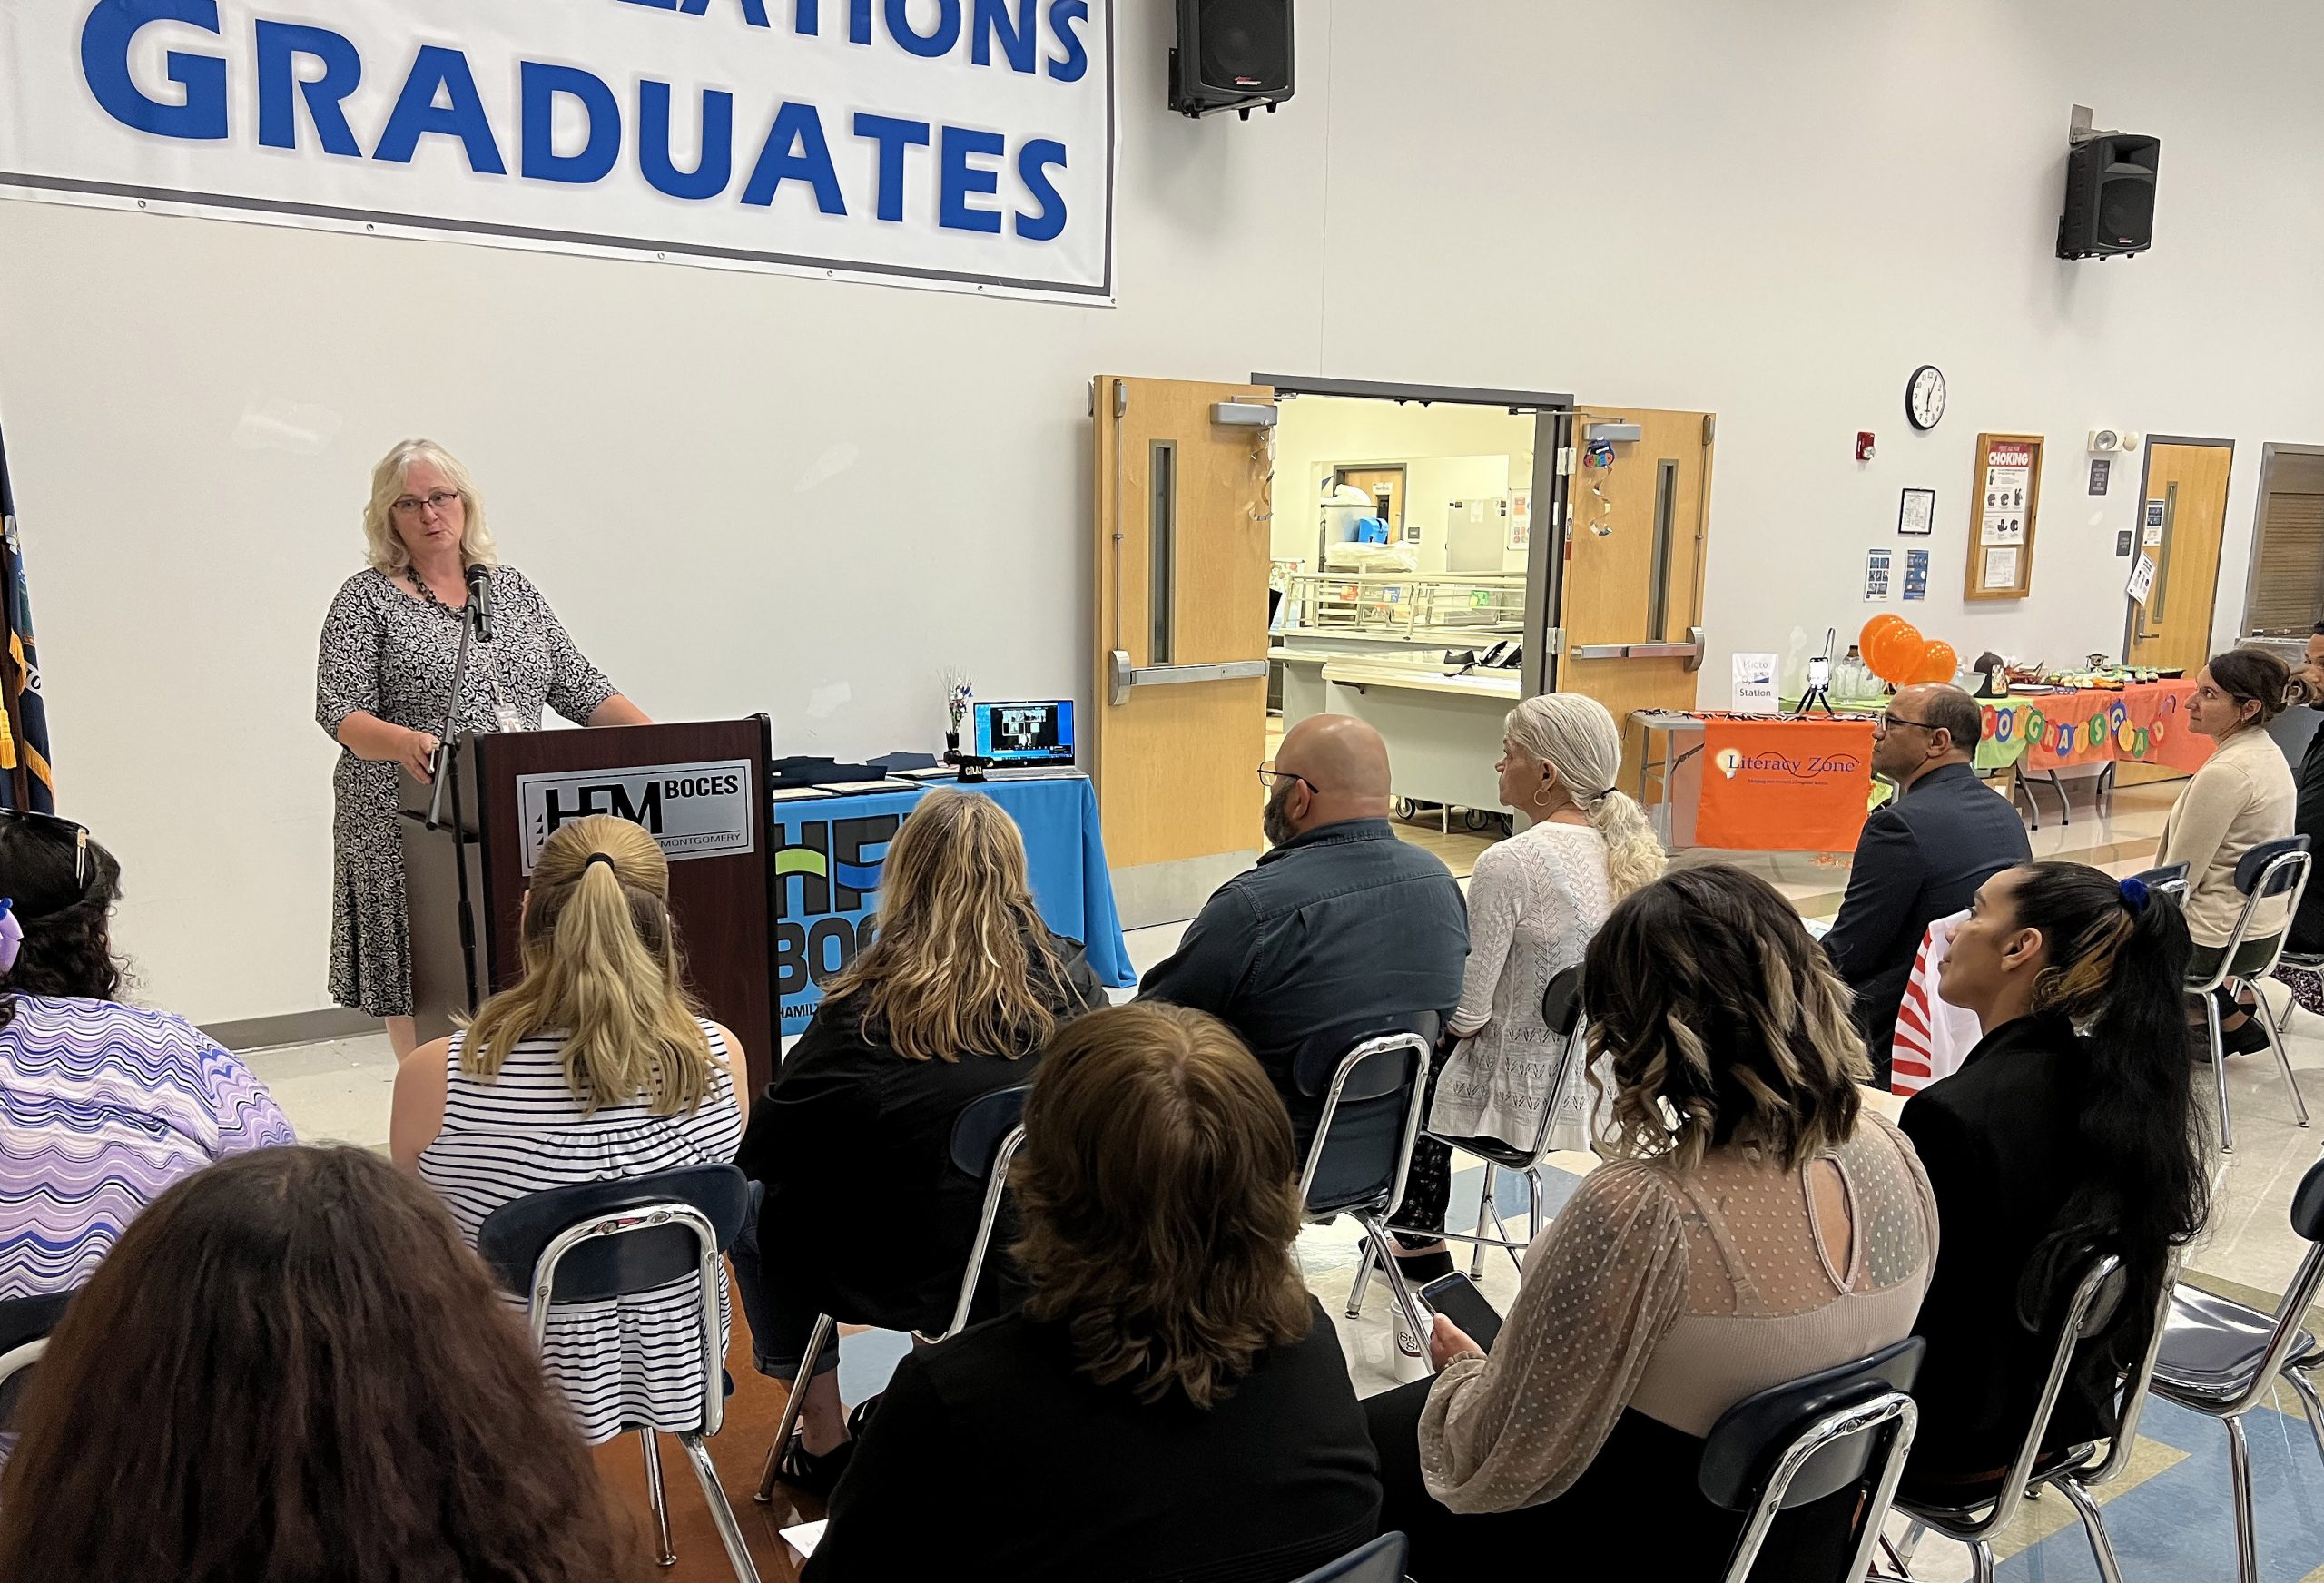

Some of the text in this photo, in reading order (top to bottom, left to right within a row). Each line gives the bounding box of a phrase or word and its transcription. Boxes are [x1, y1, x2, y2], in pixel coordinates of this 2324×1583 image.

[618, 0, 1088, 83] IONS
[81, 0, 1068, 241] GRADUATES
[1989, 451, 2029, 466] CHOKING
[1739, 688, 1771, 697] Station
[1982, 706, 2165, 752] CONGRATS GRAD
[1728, 754, 1856, 773] Literacy Zone
[665, 774, 739, 800] BOCES
[660, 833, 741, 848] MONTGOMERY
[774, 813, 912, 919] HF
